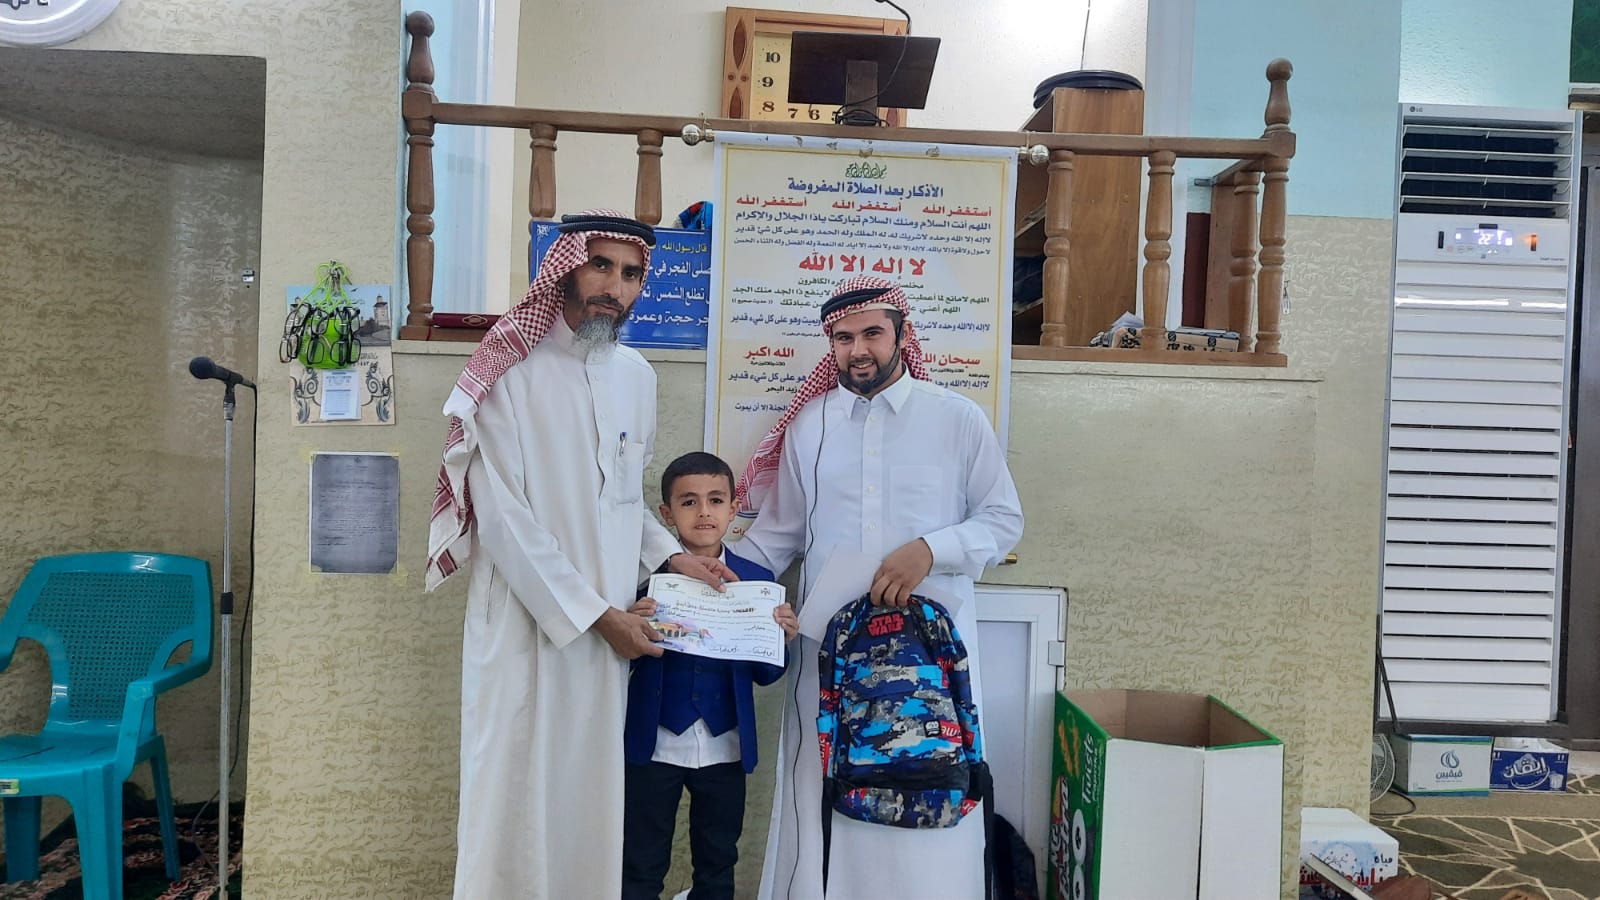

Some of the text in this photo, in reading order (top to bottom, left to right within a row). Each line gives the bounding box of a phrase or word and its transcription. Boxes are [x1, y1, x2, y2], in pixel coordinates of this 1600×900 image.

[765, 52, 781, 63] 10
[762, 76, 774, 88] 9
[762, 101, 775, 112] 8
[787, 108, 799, 119] 7
[810, 110, 820, 121] 6
[788, 177, 845, 195] المفروضة
[847, 181, 882, 195] الصلاة
[885, 185, 904, 201] بعد
[736, 194, 760, 205] الله
[832, 199, 855, 210] الله
[922, 203, 945, 214] الله
[774, 211, 807, 222] الجلال
[828, 214, 861, 225] تباركت
[862, 216, 892, 227] السلام
[893, 217, 919, 228] ومنك
[919, 219, 950, 230] السلام
[951, 220, 967, 230] أنت
[968, 222, 991, 231] اللهم
[734, 225, 755, 234] قدير
[771, 226, 783, 234] كل
[784, 227, 799, 235] على
[801, 228, 814, 236] وهو
[841, 230, 854, 238] وله
[929, 235, 950, 243] وحده
[661, 241, 675, 250] الله
[675, 243, 694, 253] رسول
[799, 249, 834, 272] الله
[909, 257, 926, 275] لا
[654, 260, 667, 277] في
[668, 261, 691, 277] الفجر
[797, 277, 830, 286] الكافرون
[656, 286, 684, 302] الشمس
[732, 286, 753, 294] الجد
[773, 287, 794, 296] الجد
[685, 287, 705, 306] تطلع
[779, 298, 811, 308] عبادتك
[629, 311, 663, 325] وعمرة
[665, 310, 694, 326] حجة
[730, 312, 748, 323] قدير
[764, 314, 775, 325] كل
[774, 315, 789, 324] على
[773, 346, 794, 358] الله
[921, 352, 981, 368] سبحان الل
[728, 370, 749, 381] قدير
[767, 372, 779, 382] كل
[780, 373, 795, 383] على
[734, 402, 752, 411] يموت
